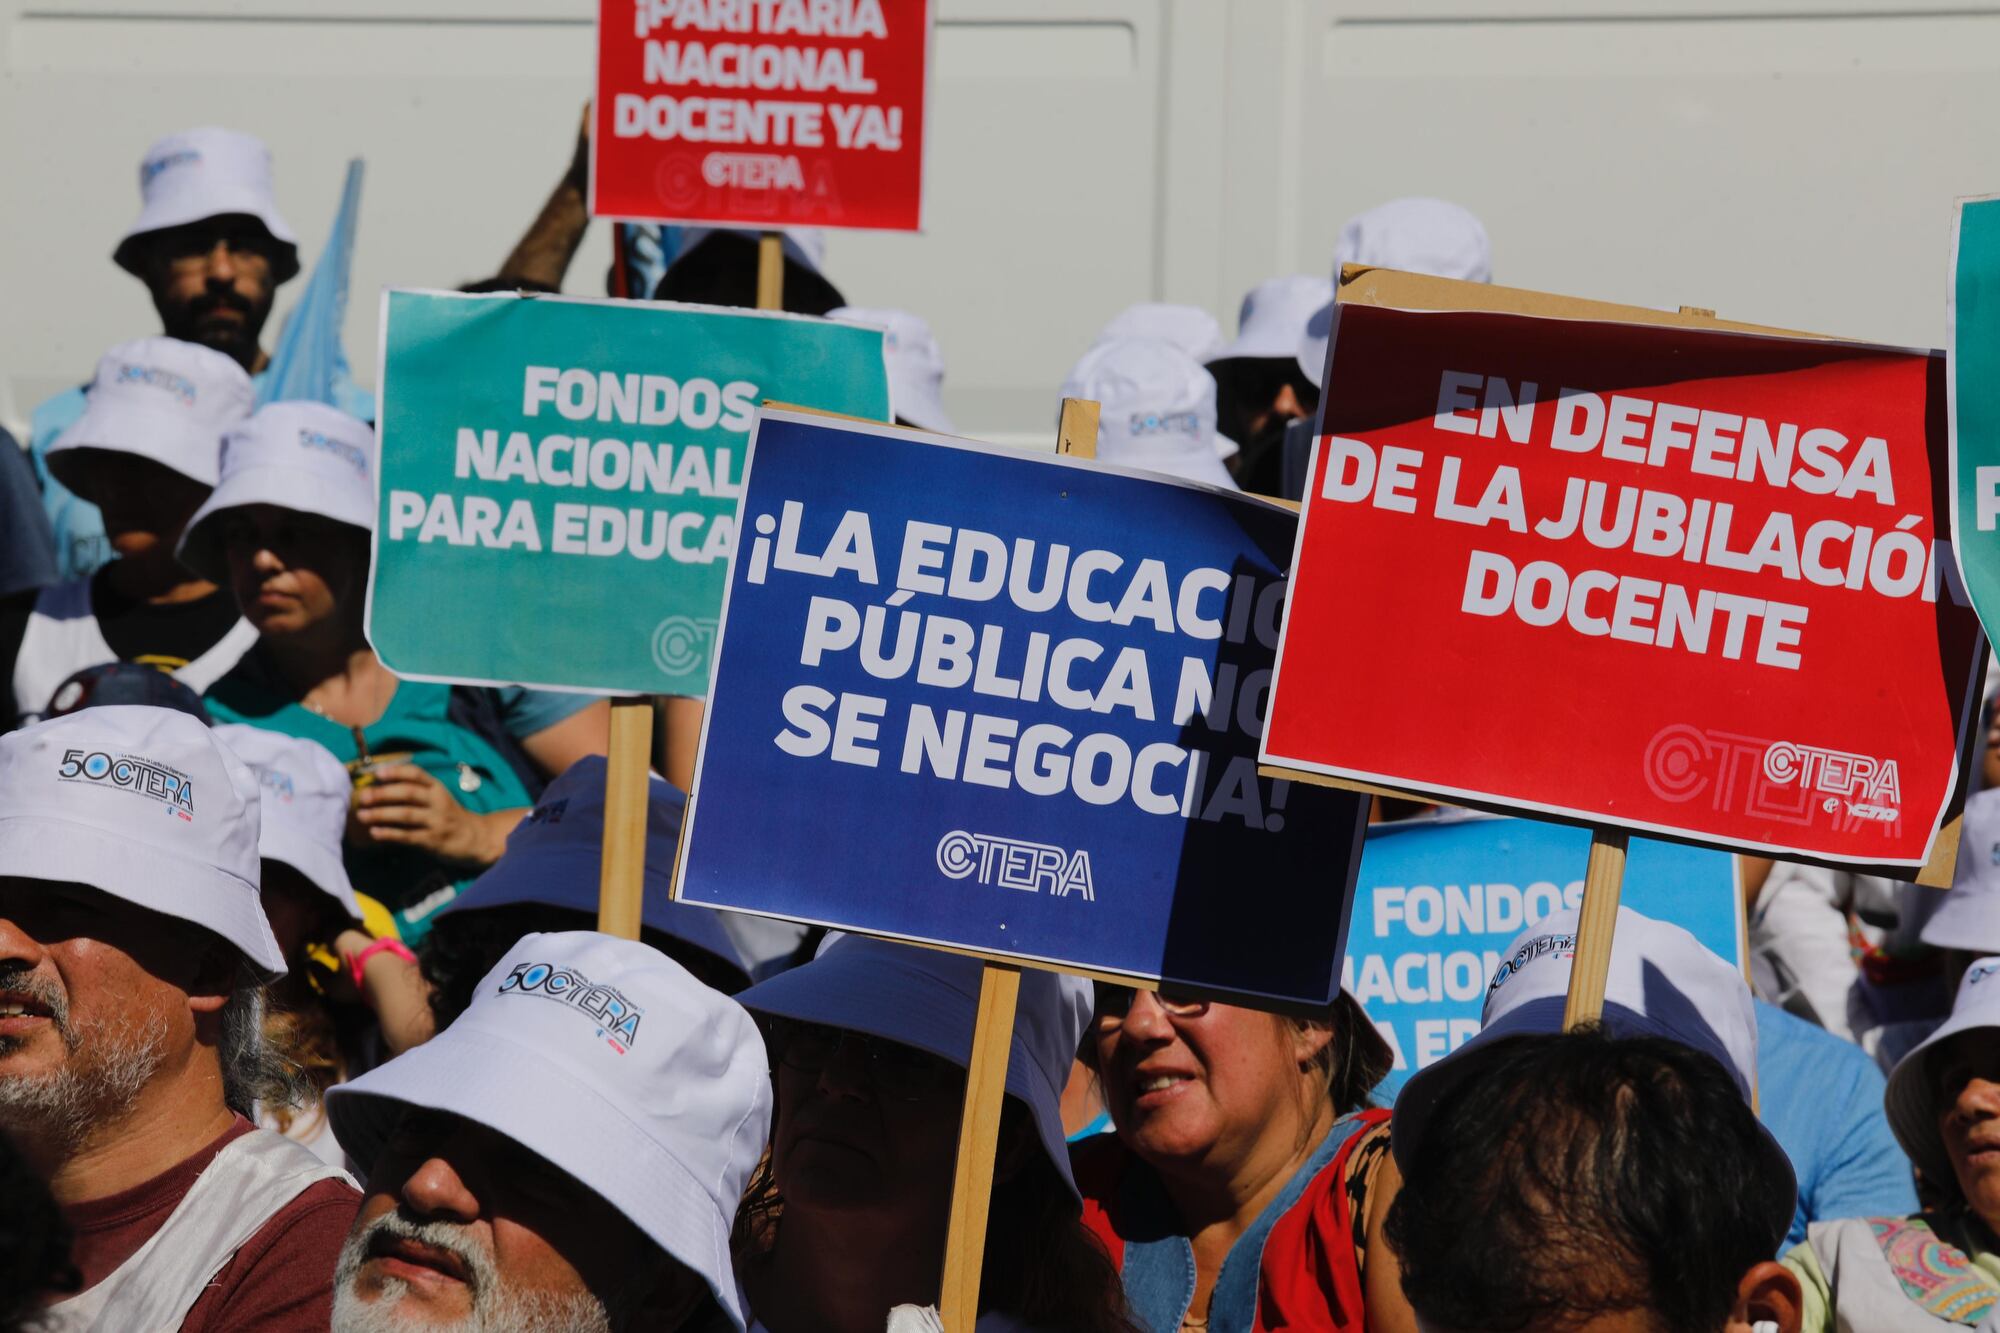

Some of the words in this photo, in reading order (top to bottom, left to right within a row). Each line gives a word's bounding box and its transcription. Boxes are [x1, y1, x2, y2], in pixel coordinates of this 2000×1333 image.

[644, 40, 876, 94] NACIONAL
[615, 94, 824, 147] DOCENTE
[829, 104, 902, 151] YA!
[702, 152, 803, 189] CTERA
[523, 365, 758, 432] FONDOS
[1434, 371, 1537, 444] EN
[1550, 388, 1896, 506] DEFENSA
[389, 490, 541, 551] PARA
[1321, 436, 1424, 514] DE
[1434, 456, 1528, 534] LA
[747, 500, 878, 584] ¡LA
[1461, 550, 1809, 670] DOCENTE
[801, 590, 1155, 721] PÚBLICA
[774, 685, 887, 767] SE
[901, 704, 1287, 833] NEGOCIA!
[1764, 741, 1901, 804] CTERA
[937, 830, 1094, 901] CTERA
